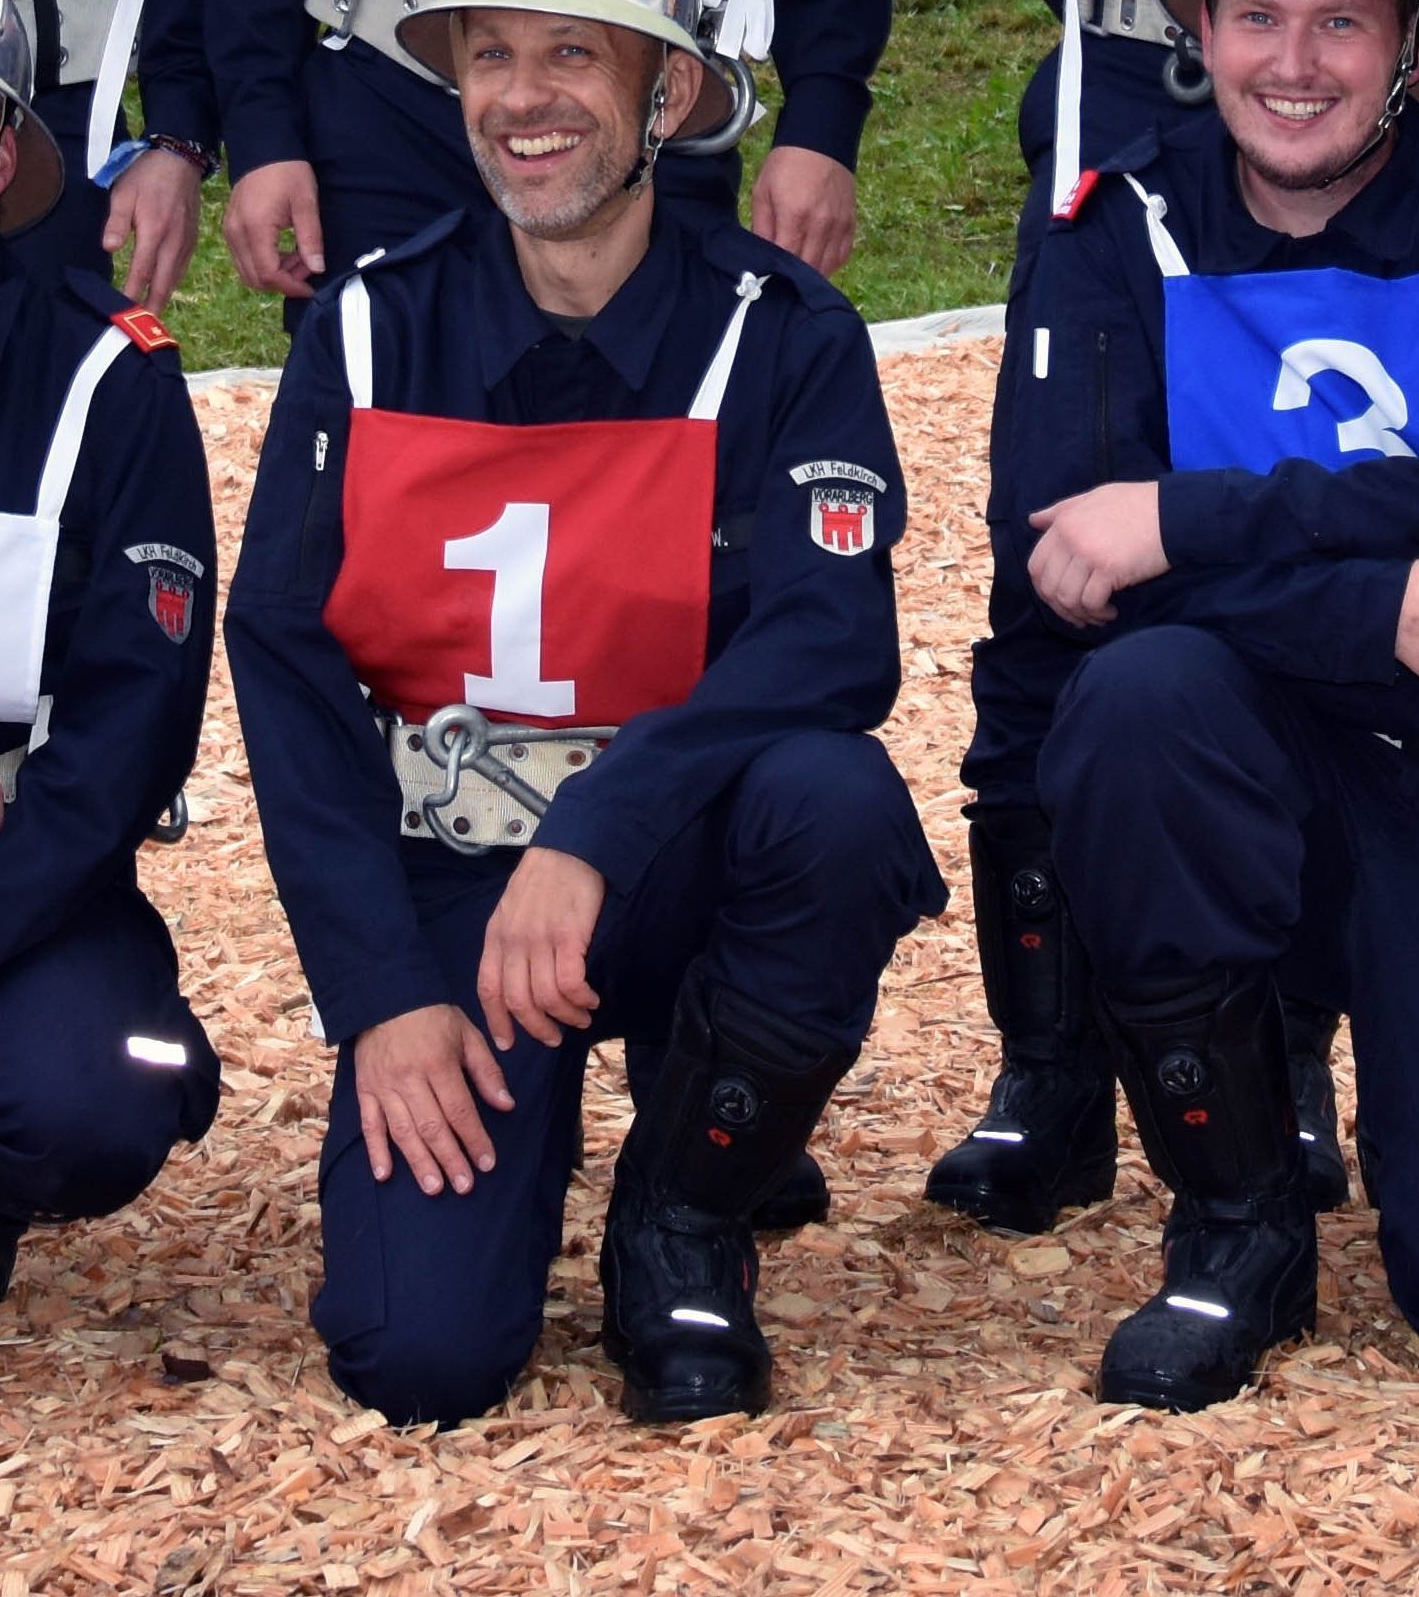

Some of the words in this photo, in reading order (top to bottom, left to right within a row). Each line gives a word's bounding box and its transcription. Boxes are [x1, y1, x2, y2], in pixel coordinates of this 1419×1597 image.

[803, 464, 825, 479] LKH
[830, 462, 879, 487] Feldkirch
[813, 490, 874, 505] VORARLBERG
[444, 502, 576, 717] 1
